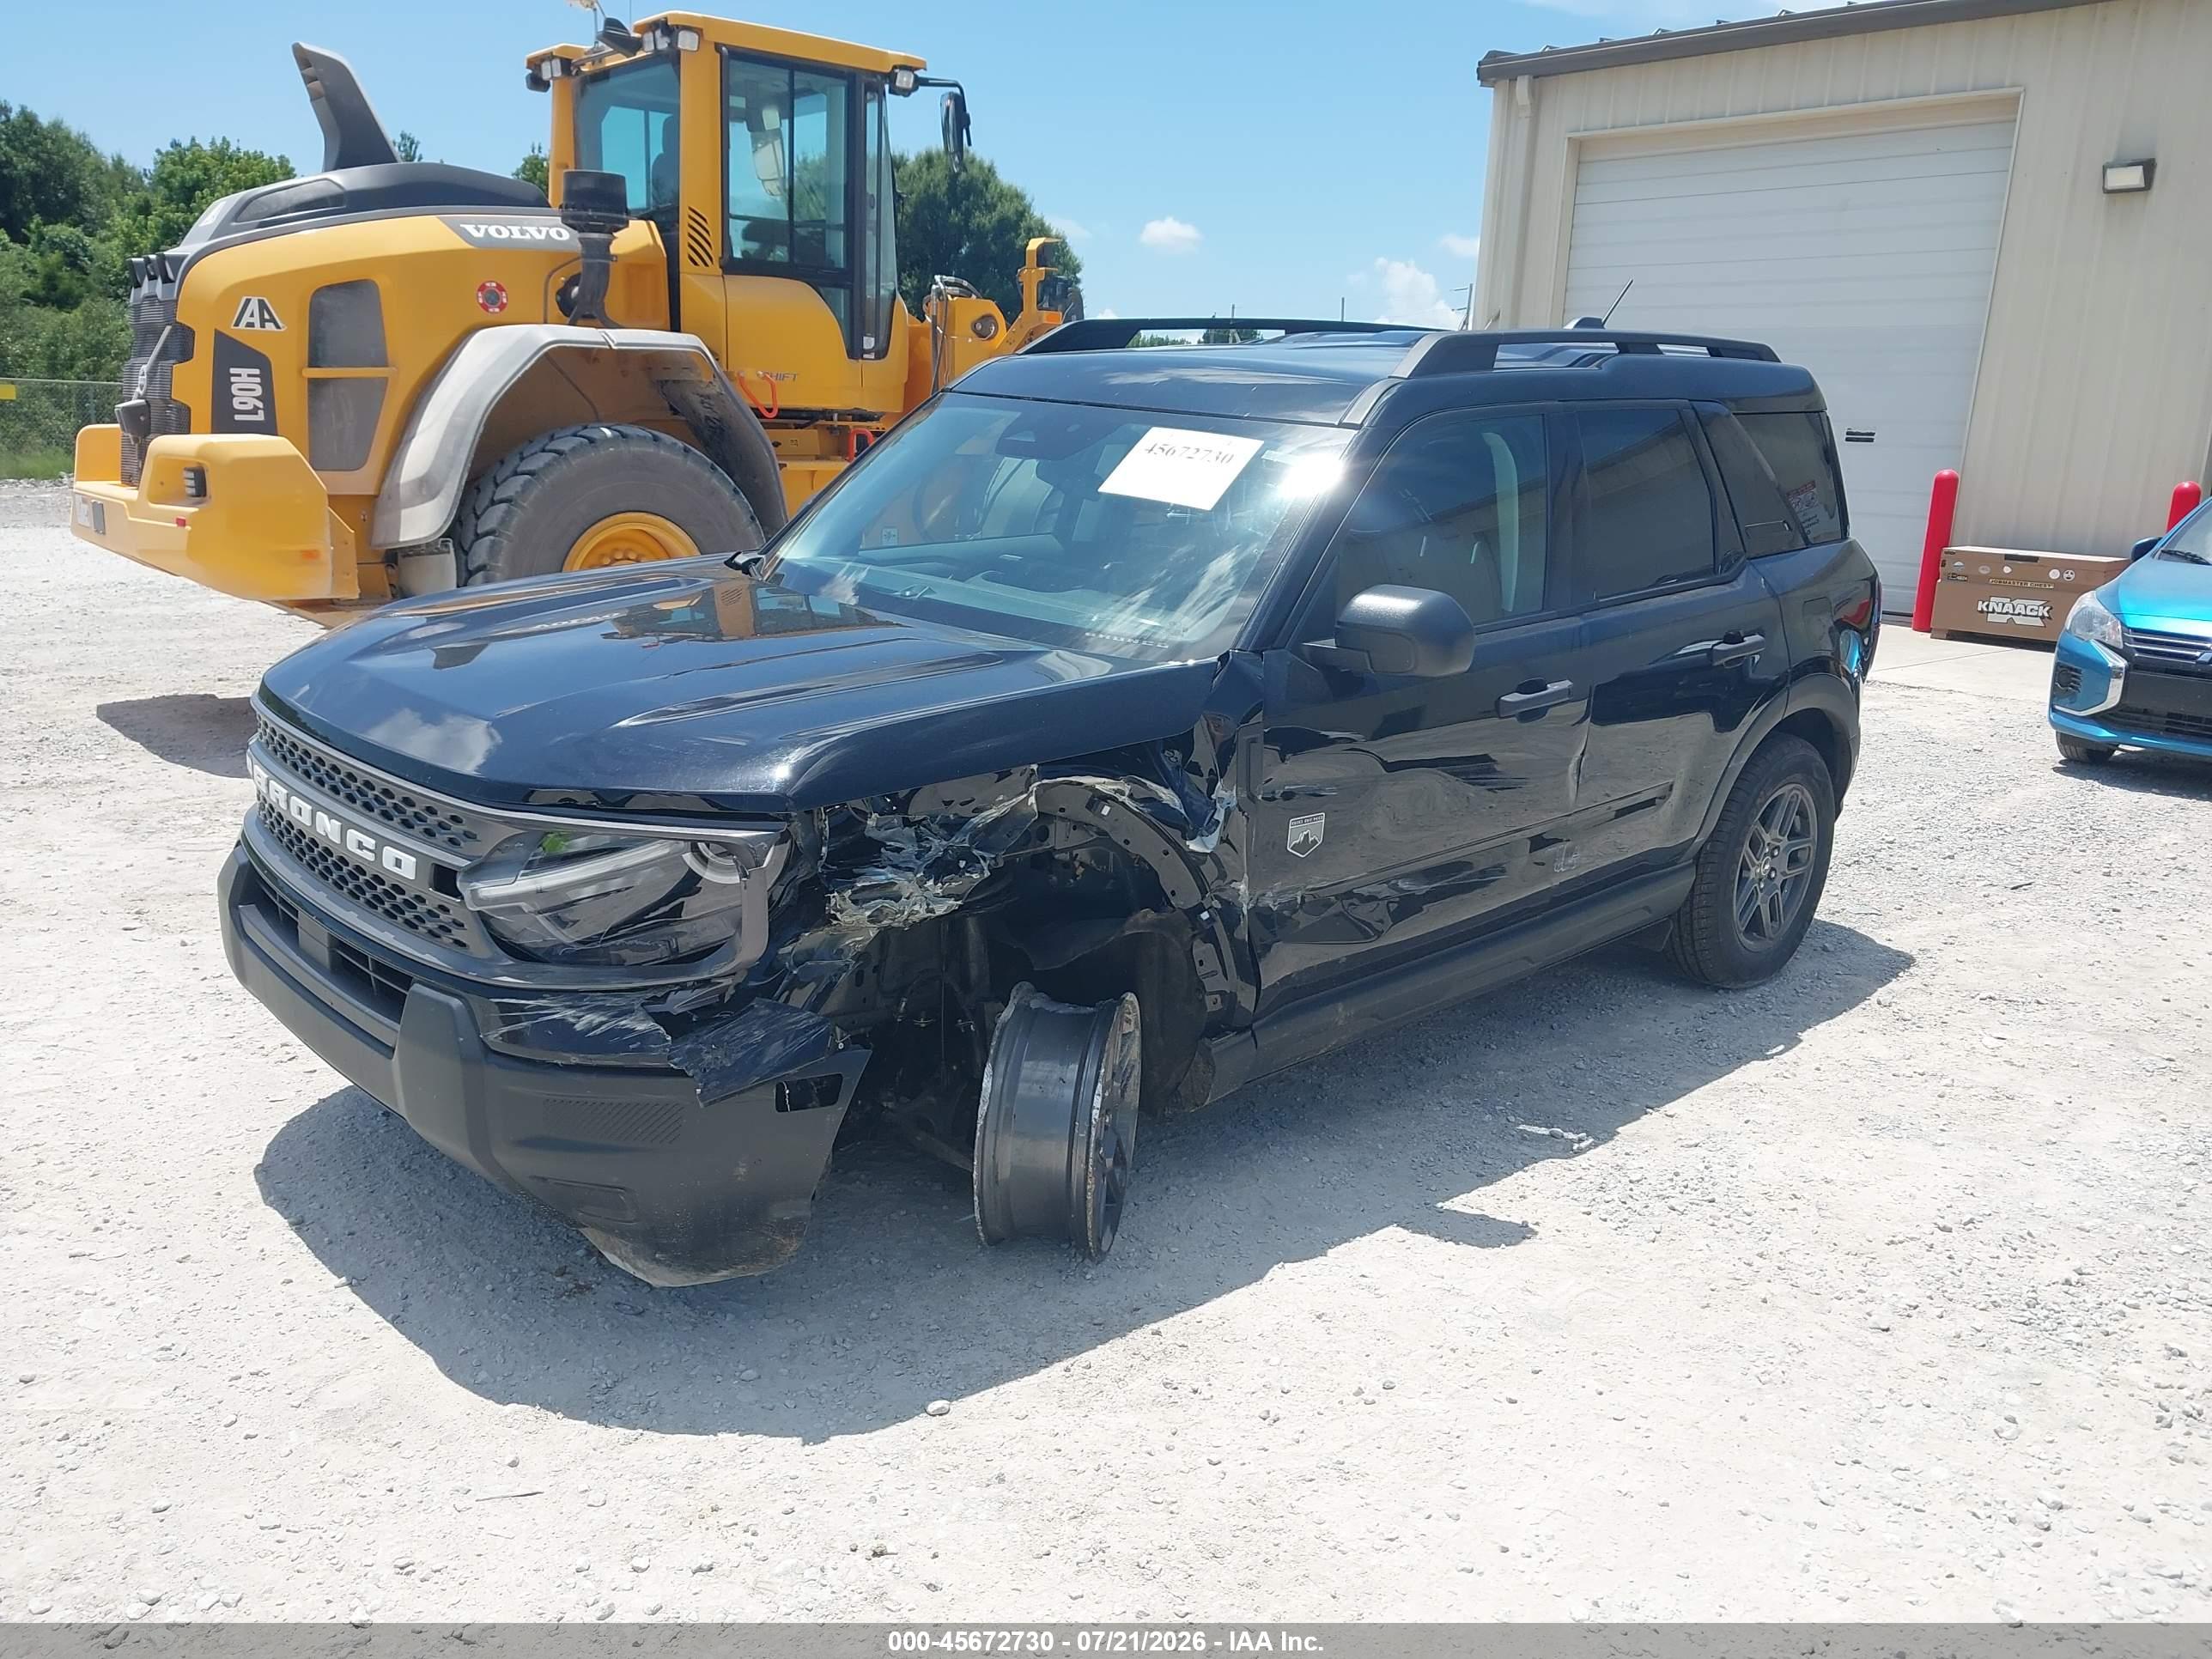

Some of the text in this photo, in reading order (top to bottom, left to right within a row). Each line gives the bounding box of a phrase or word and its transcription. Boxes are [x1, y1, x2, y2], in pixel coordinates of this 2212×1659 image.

[459, 223, 570, 241] VOLVO
[231, 296, 285, 331] IAA
[229, 367, 265, 422] L90H
[1144, 442, 1235, 465] 45672730
[1990, 579, 2028, 587] JOBMASTER
[1977, 600, 2052, 618] KNAACK
[254, 764, 416, 880] BRONCO
